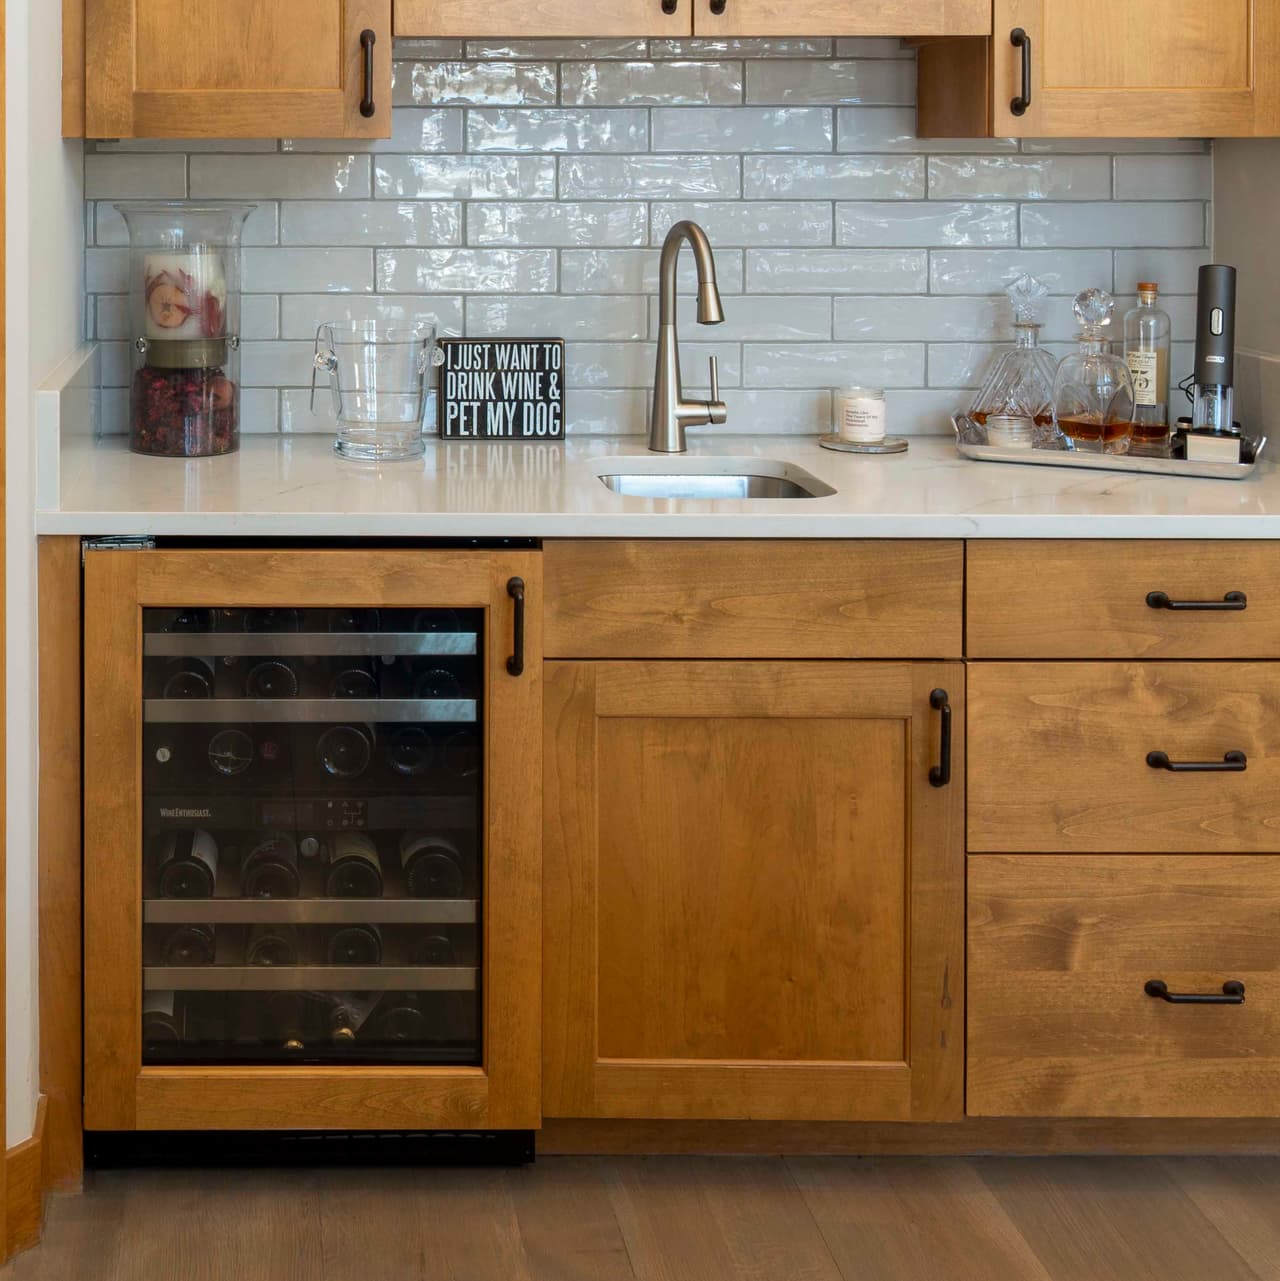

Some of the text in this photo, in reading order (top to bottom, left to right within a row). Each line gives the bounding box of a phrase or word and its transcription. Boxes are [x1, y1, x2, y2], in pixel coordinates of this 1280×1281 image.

[447, 344, 561, 370] I JUST WANT TO
[446, 372, 561, 400] DRINK WINE &
[446, 402, 561, 436] PET MY DOG
